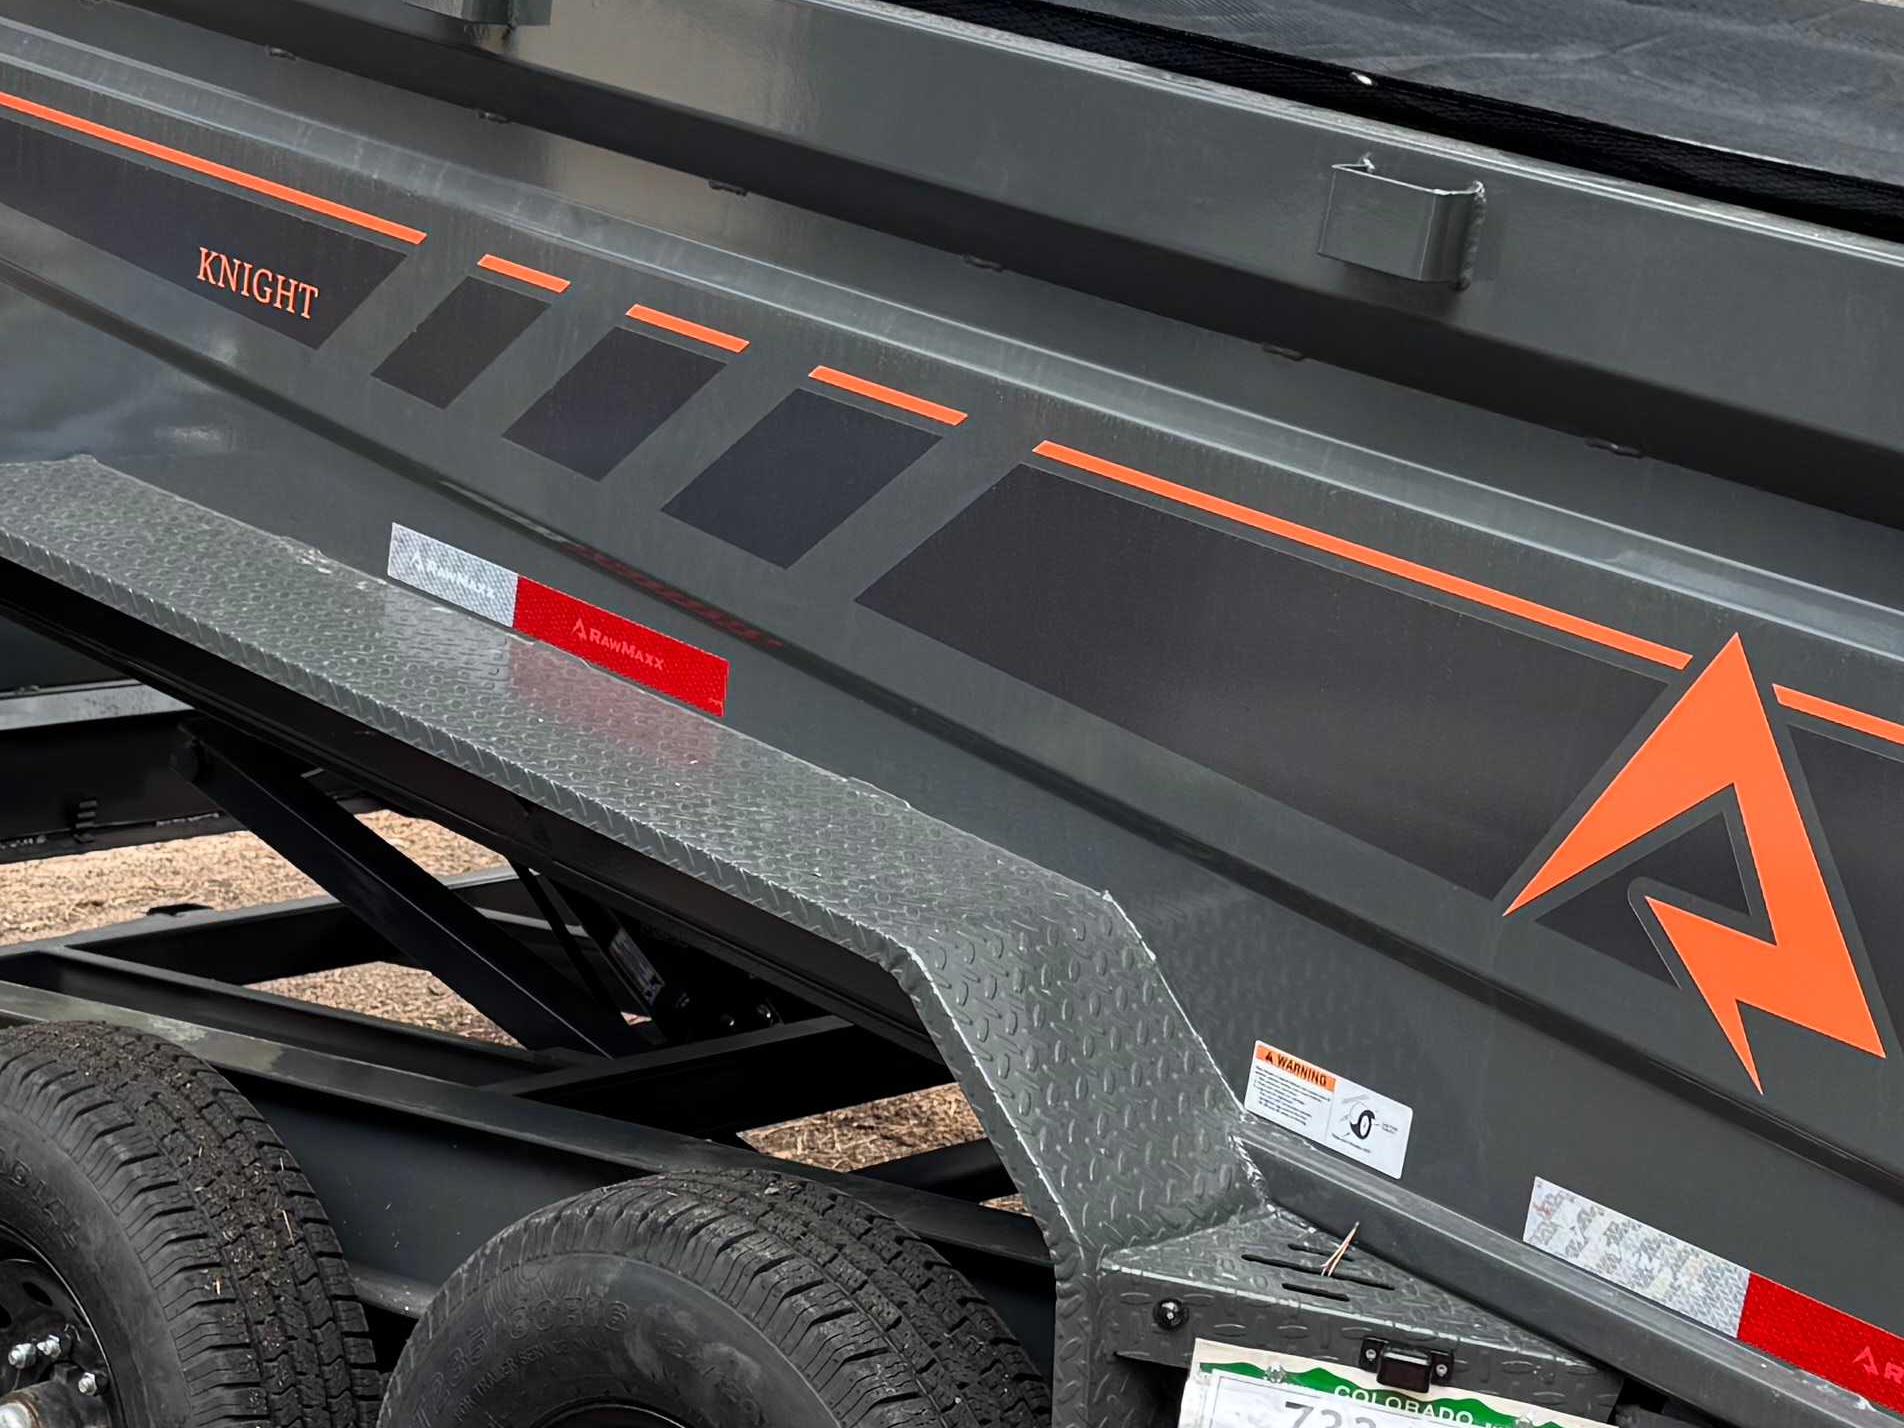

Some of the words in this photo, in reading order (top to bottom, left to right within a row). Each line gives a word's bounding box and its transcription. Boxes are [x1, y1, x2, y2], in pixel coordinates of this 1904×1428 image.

[197, 247, 319, 320] KNIGHT
[1276, 1054, 1327, 1087] WARNING
[1334, 1385, 1474, 1425] COLORADO
